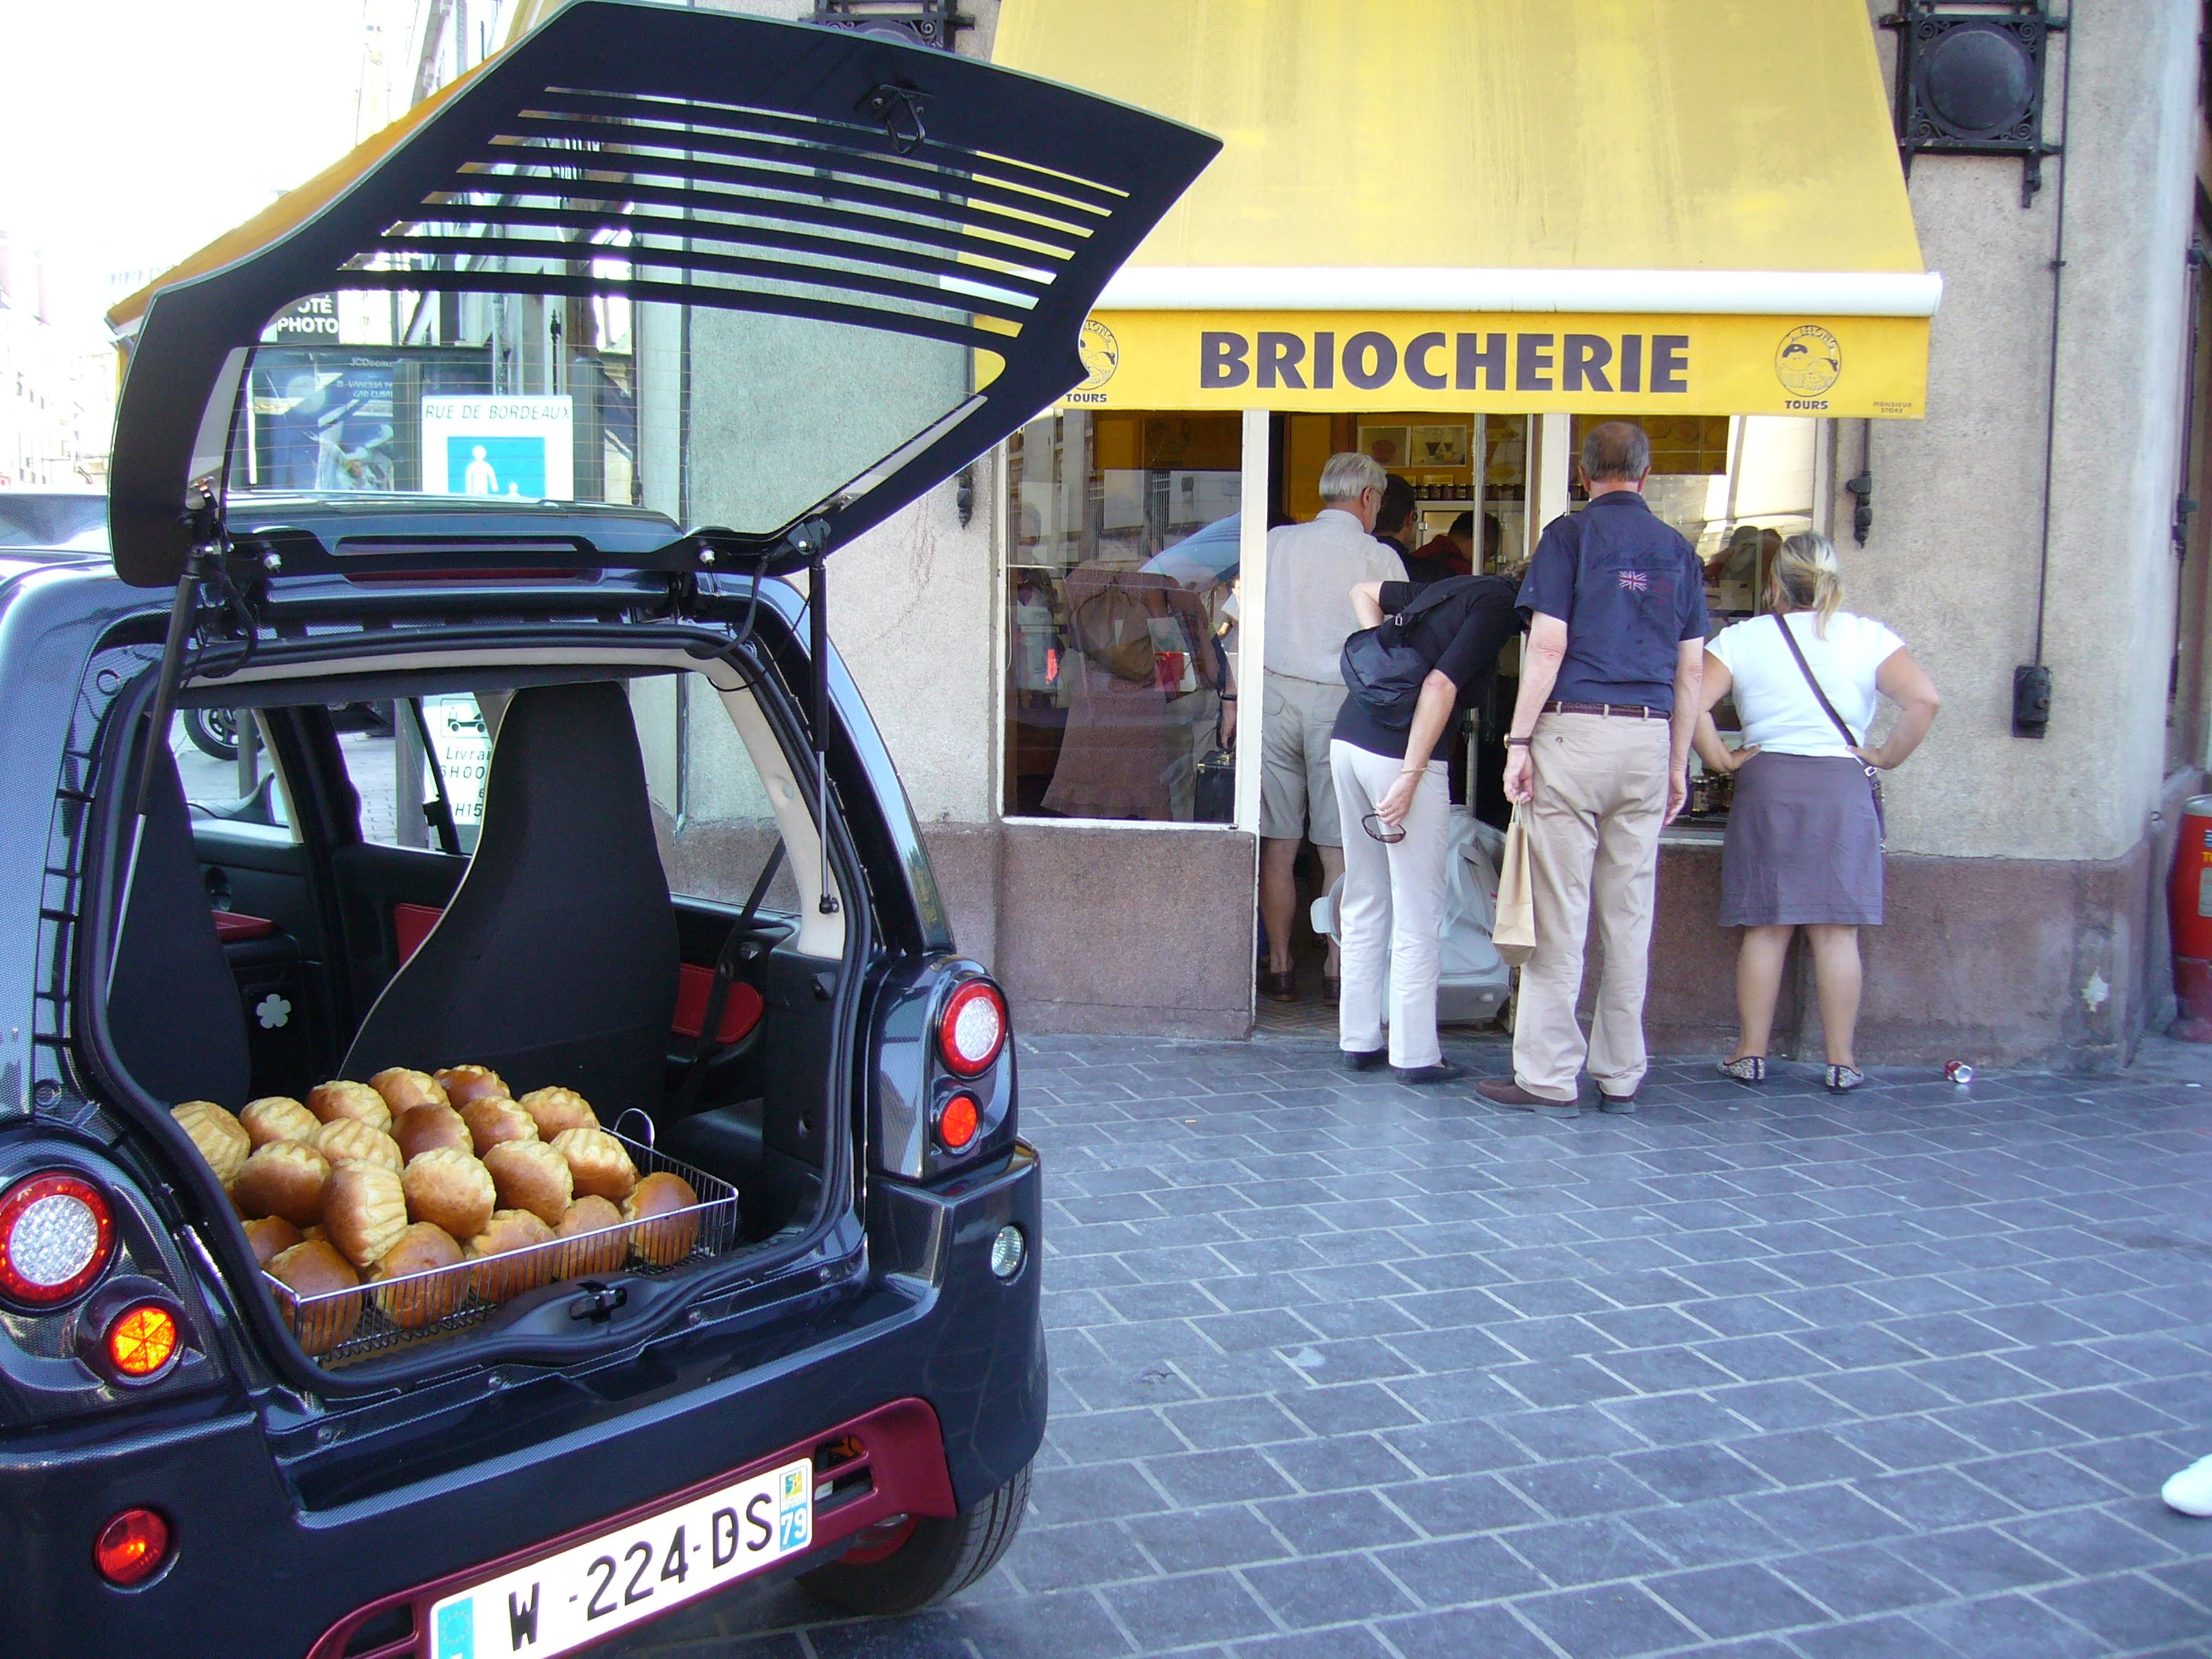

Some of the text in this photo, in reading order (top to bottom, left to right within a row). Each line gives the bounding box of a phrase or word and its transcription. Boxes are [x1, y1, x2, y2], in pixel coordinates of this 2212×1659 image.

[277, 317, 339, 334] PHOTO
[1200, 331, 1689, 393] BRIOCHERIE
[1066, 394, 1107, 403] TOURS
[1785, 400, 1829, 410] TOURS
[425, 405, 569, 419] RUE DE BORDEAUX
[782, 1507, 808, 1547] 79
